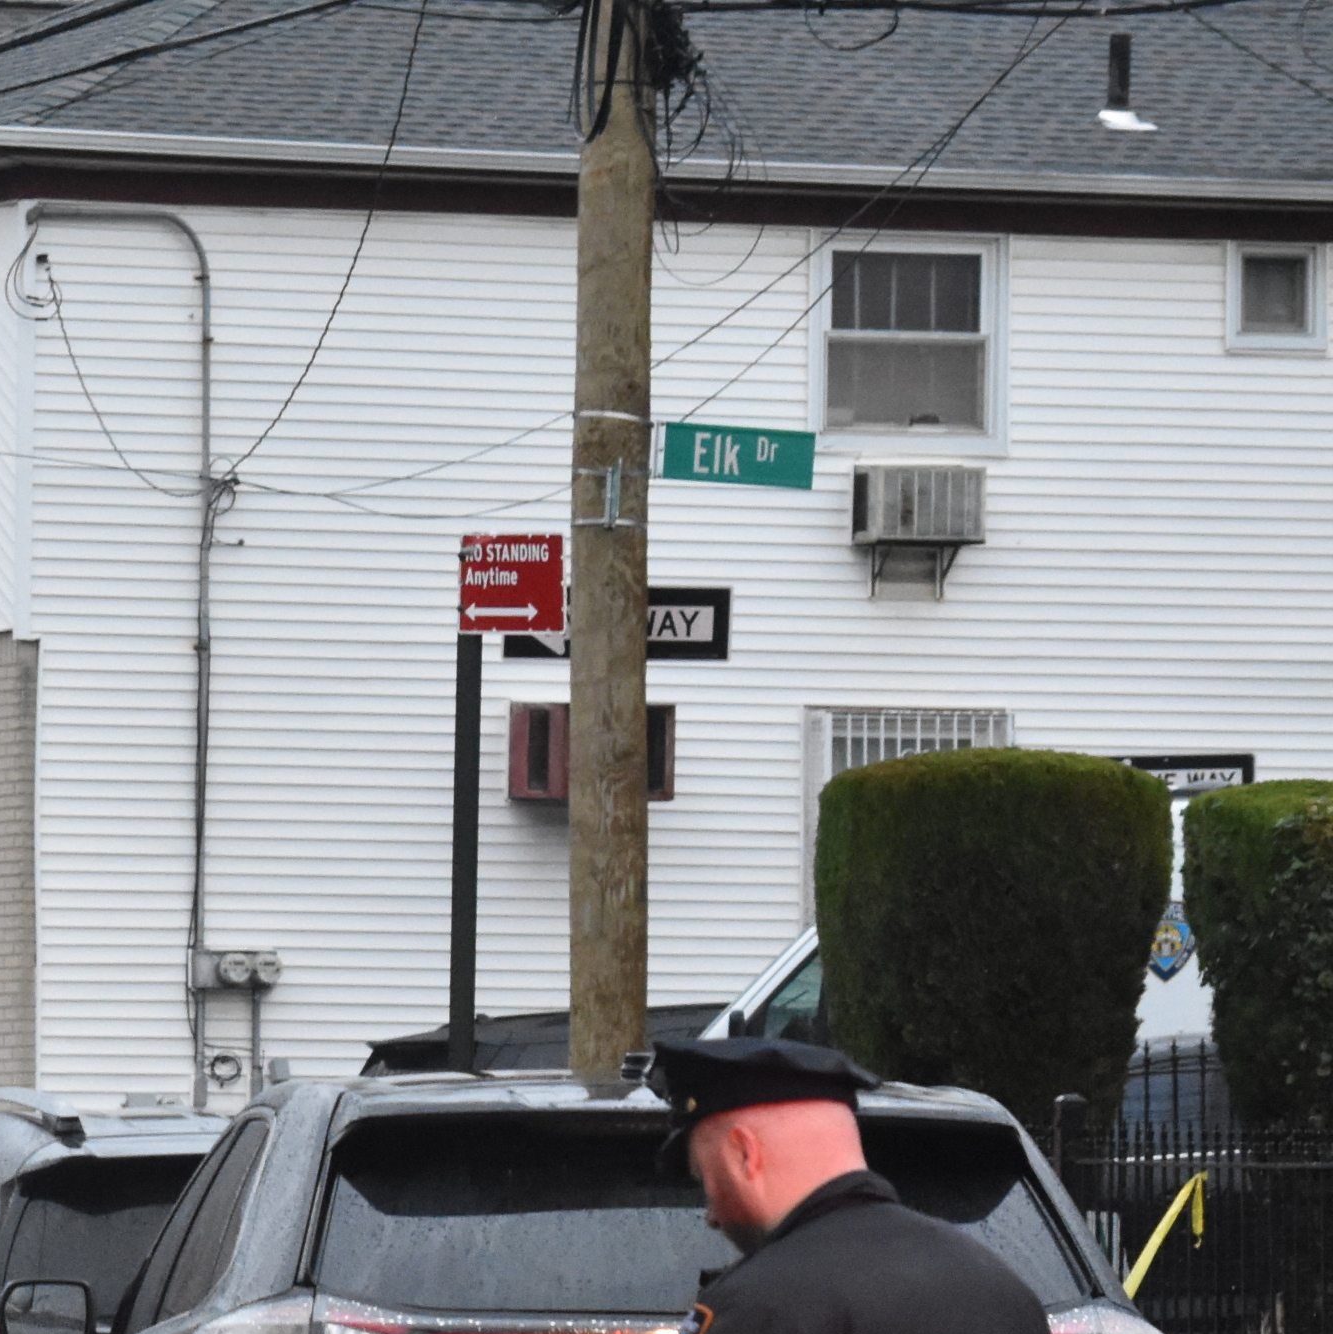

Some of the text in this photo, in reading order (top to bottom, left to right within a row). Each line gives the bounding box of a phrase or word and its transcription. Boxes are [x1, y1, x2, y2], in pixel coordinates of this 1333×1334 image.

[692, 431, 780, 477] Elk Dr
[486, 543, 550, 563] STANDING
[465, 567, 519, 590] Anytime
